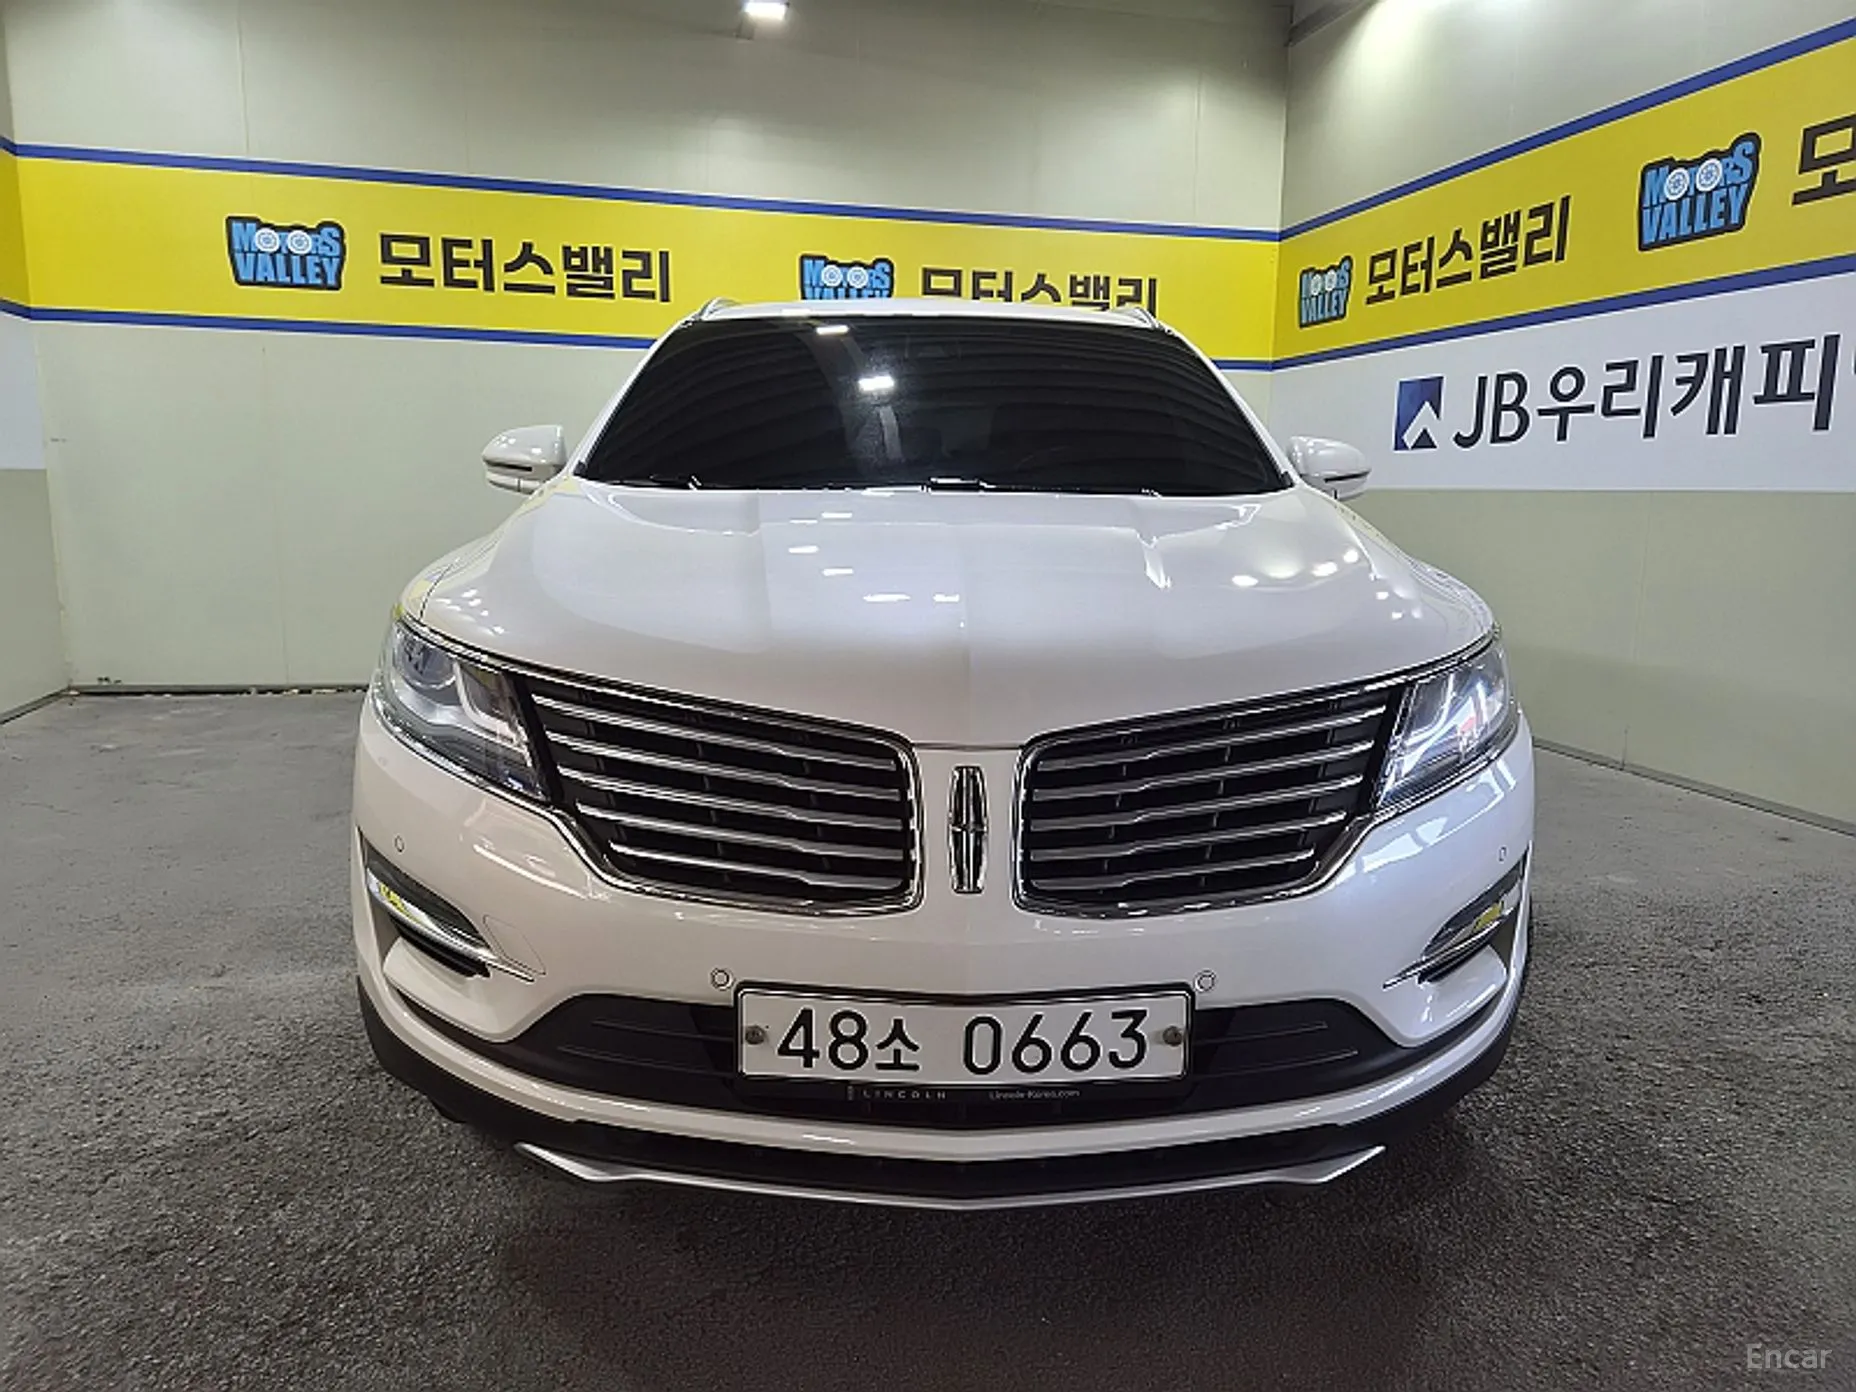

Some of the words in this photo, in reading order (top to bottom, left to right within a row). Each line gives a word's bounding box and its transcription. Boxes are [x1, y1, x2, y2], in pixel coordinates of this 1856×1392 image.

[1643, 141, 1755, 207] MOTORS
[231, 222, 341, 255] MOTORS
[1642, 183, 1748, 245] VALLEY
[234, 252, 340, 286] VALLEY
[379, 233, 671, 303] 모터스밸리
[1365, 196, 1570, 305] 모터스밸리
[1452, 333, 1856, 450] JB우리캐피
[777, 1008, 921, 1071] 48소
[963, 1009, 1148, 1075] 0663
